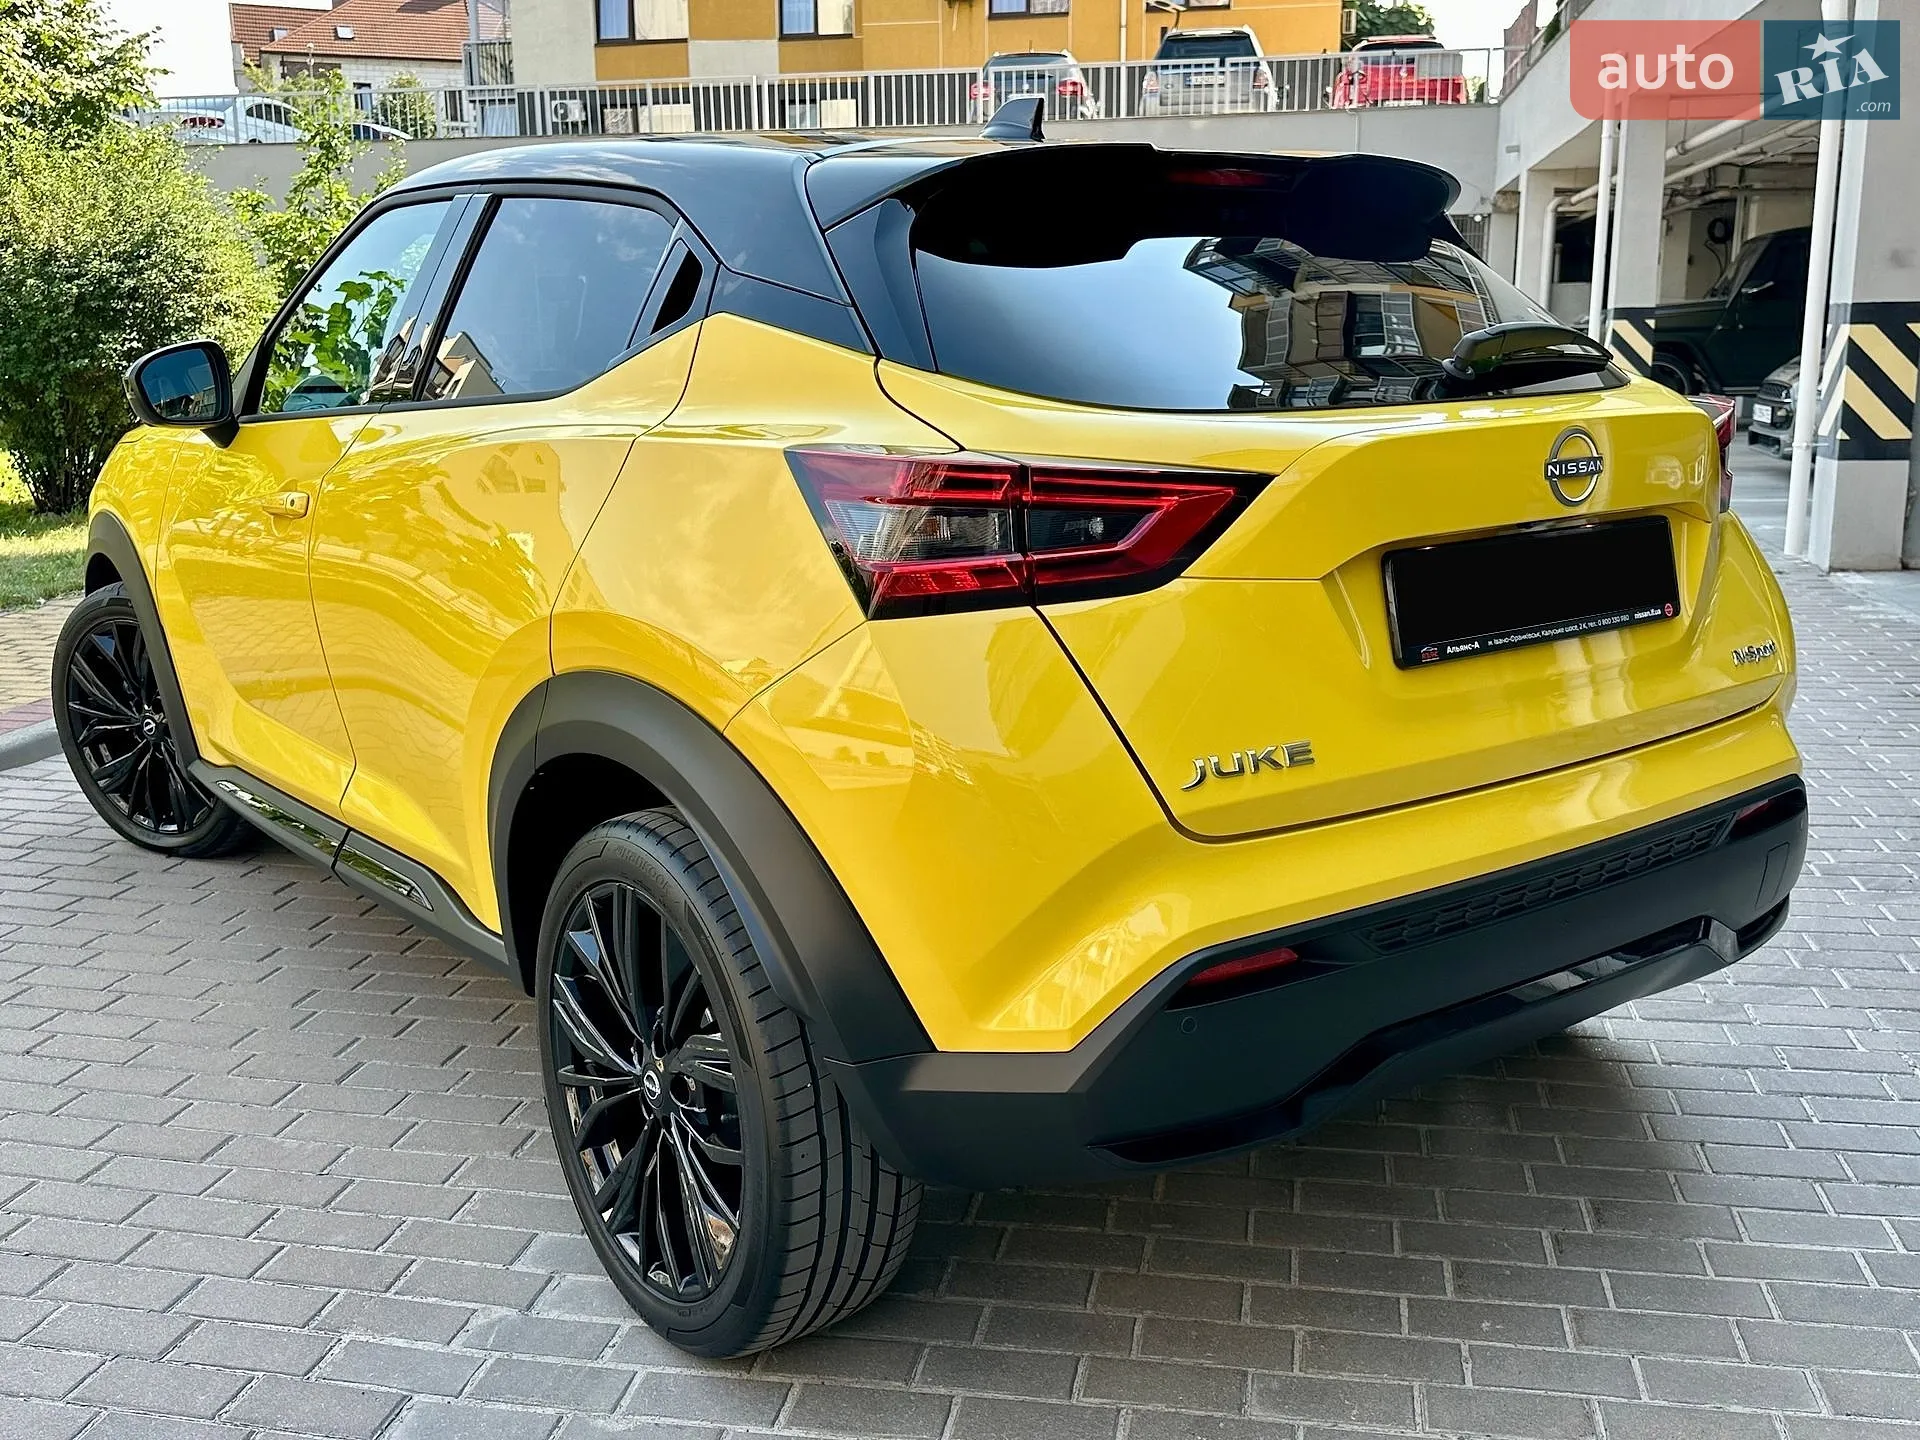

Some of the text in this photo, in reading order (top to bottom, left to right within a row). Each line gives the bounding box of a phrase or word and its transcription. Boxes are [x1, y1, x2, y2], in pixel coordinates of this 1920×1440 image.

[1547, 460, 1603, 477] NISSAN
[1446, 640, 1480, 654] Альянс-А
[1180, 739, 1315, 792] JUKE
